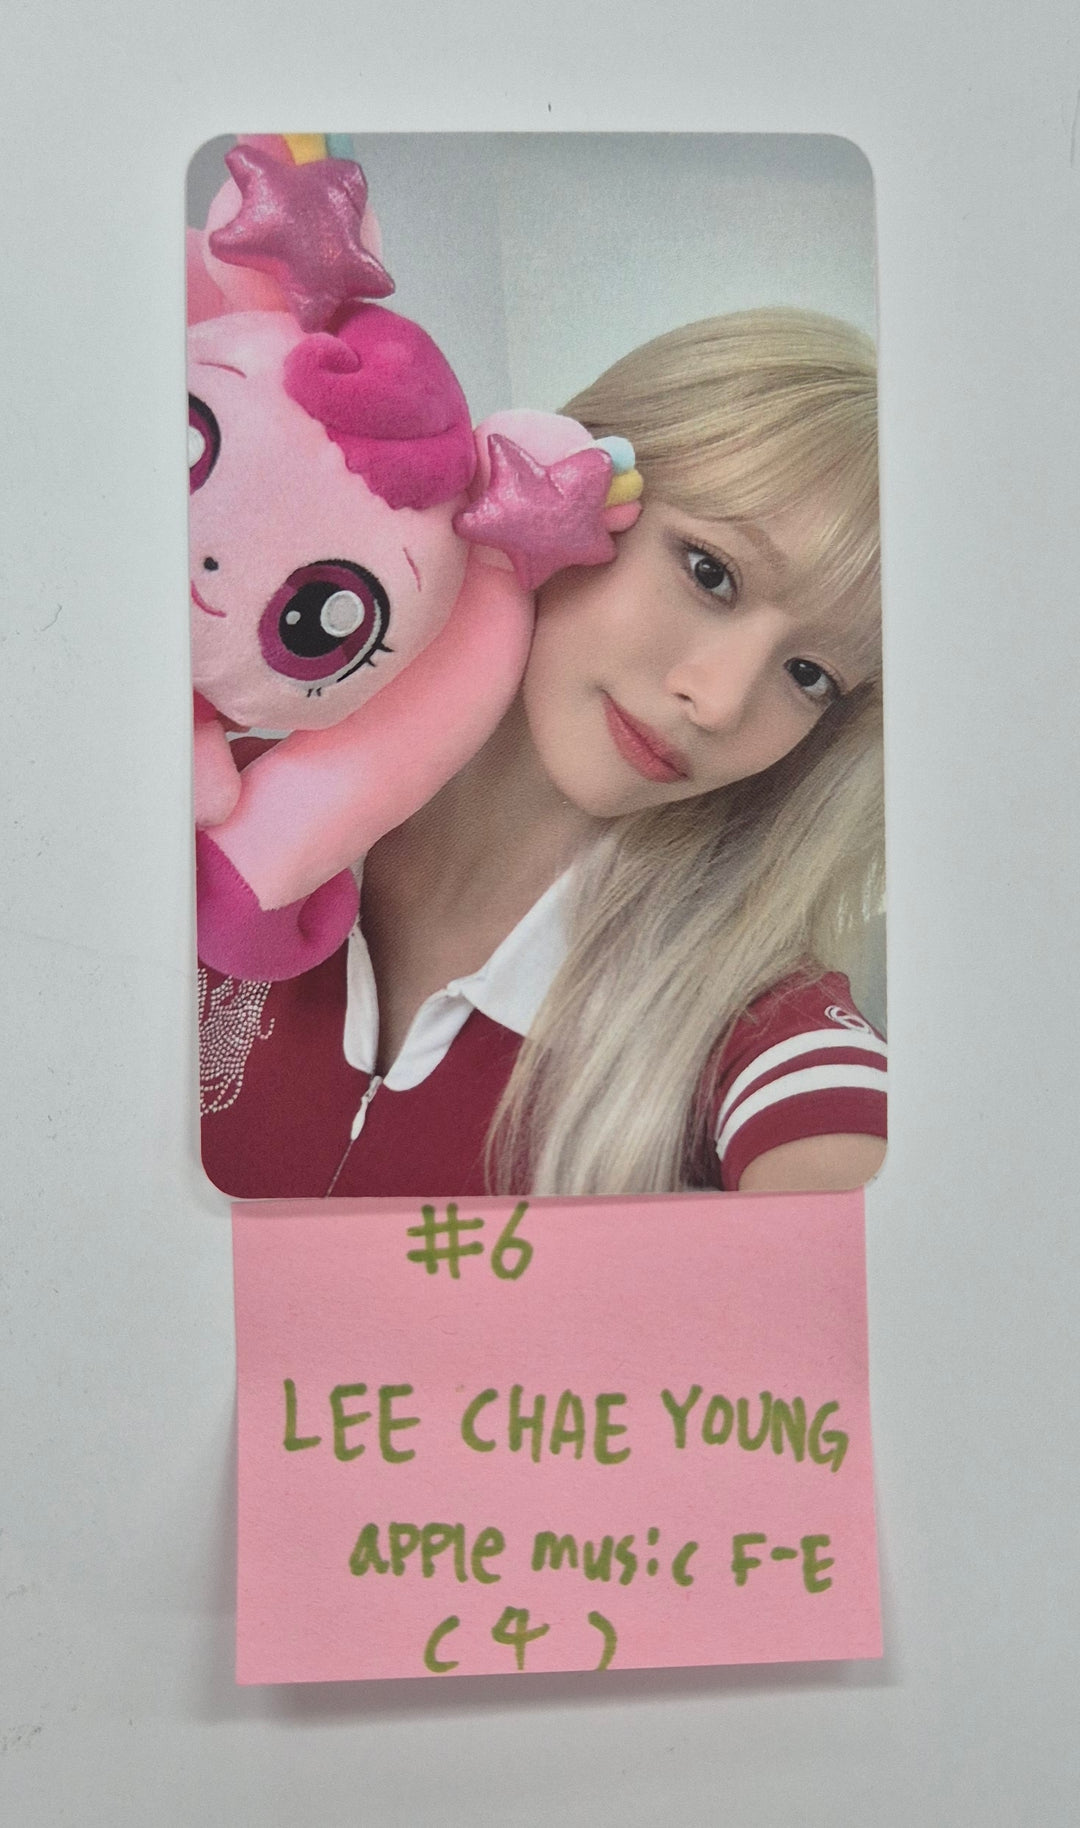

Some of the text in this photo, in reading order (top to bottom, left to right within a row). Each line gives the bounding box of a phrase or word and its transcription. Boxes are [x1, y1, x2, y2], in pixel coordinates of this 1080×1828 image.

[406, 1202, 533, 1281] #6
[282, 1380, 850, 1473] LEE CHAE YOUNG
[530, 1527, 699, 1588] music
[730, 1534, 835, 1595] F-E
